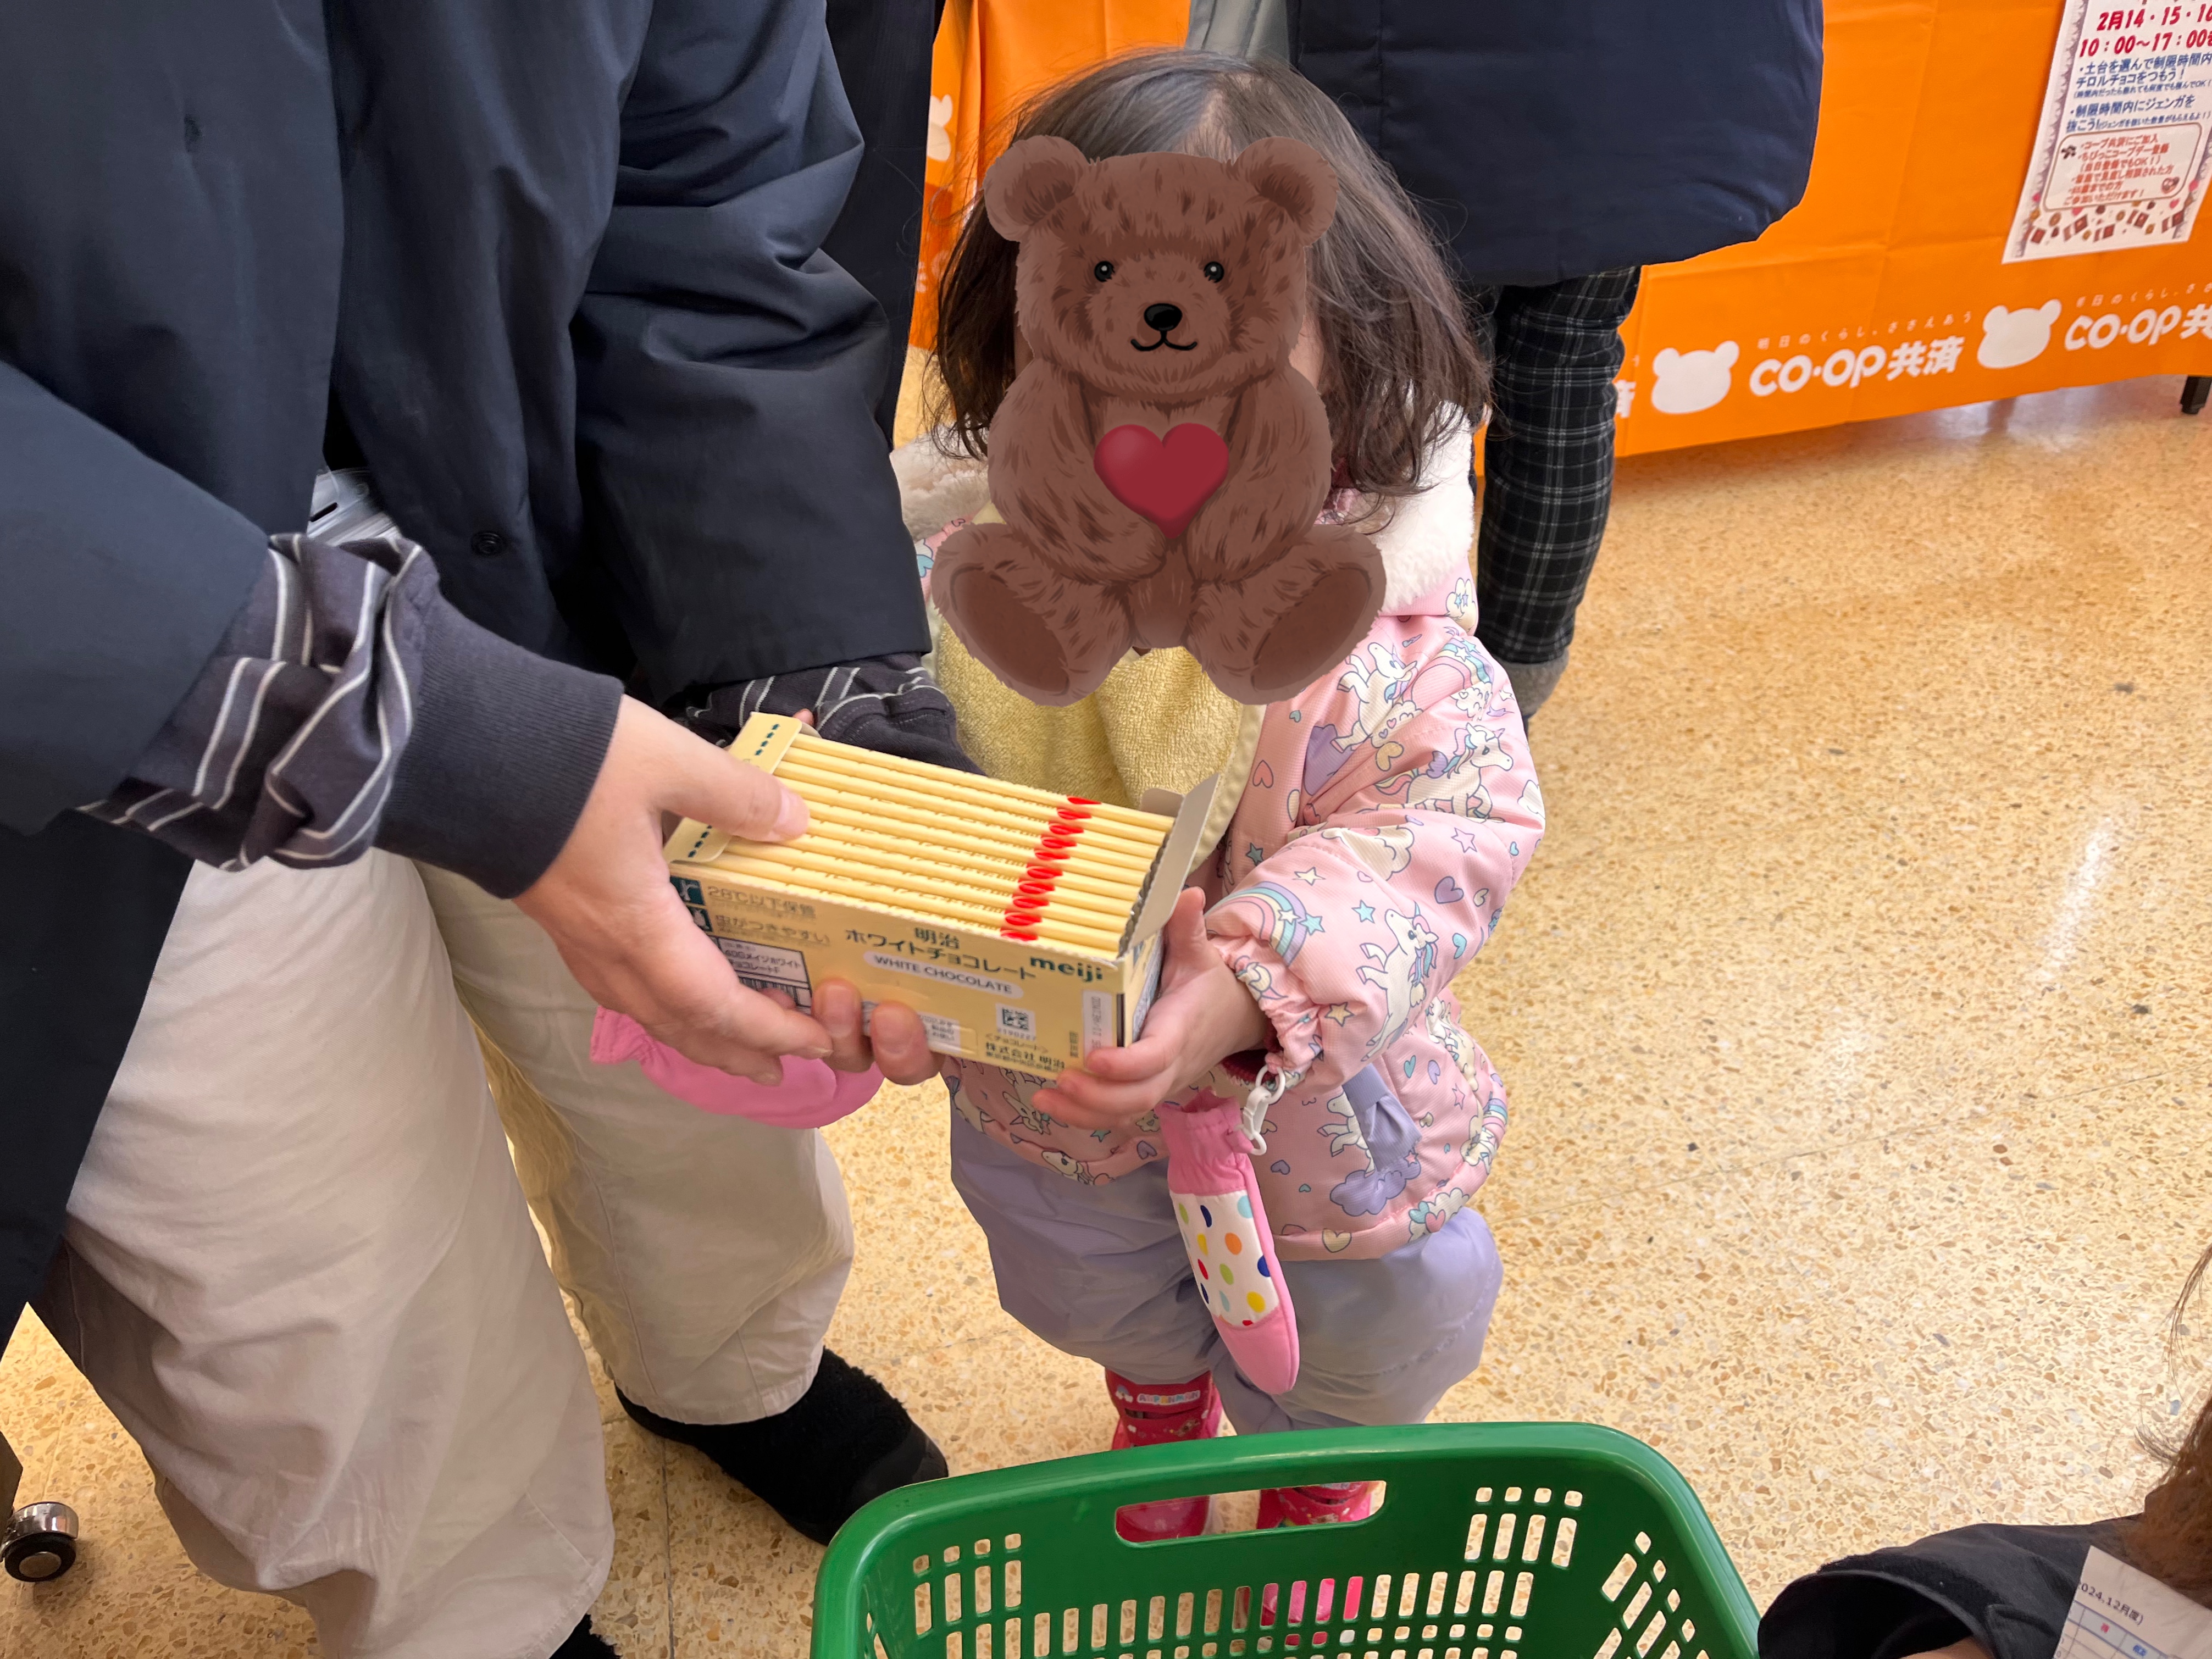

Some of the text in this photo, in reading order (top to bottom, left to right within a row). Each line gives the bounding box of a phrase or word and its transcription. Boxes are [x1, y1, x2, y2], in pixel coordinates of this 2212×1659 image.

[845, 928, 1036, 980] ホワイトチョコレート
[914, 927, 960, 950] 明治
[874, 953, 1013, 994] WHITE CHOCOLATE
[1029, 956, 1103, 983] meiji
